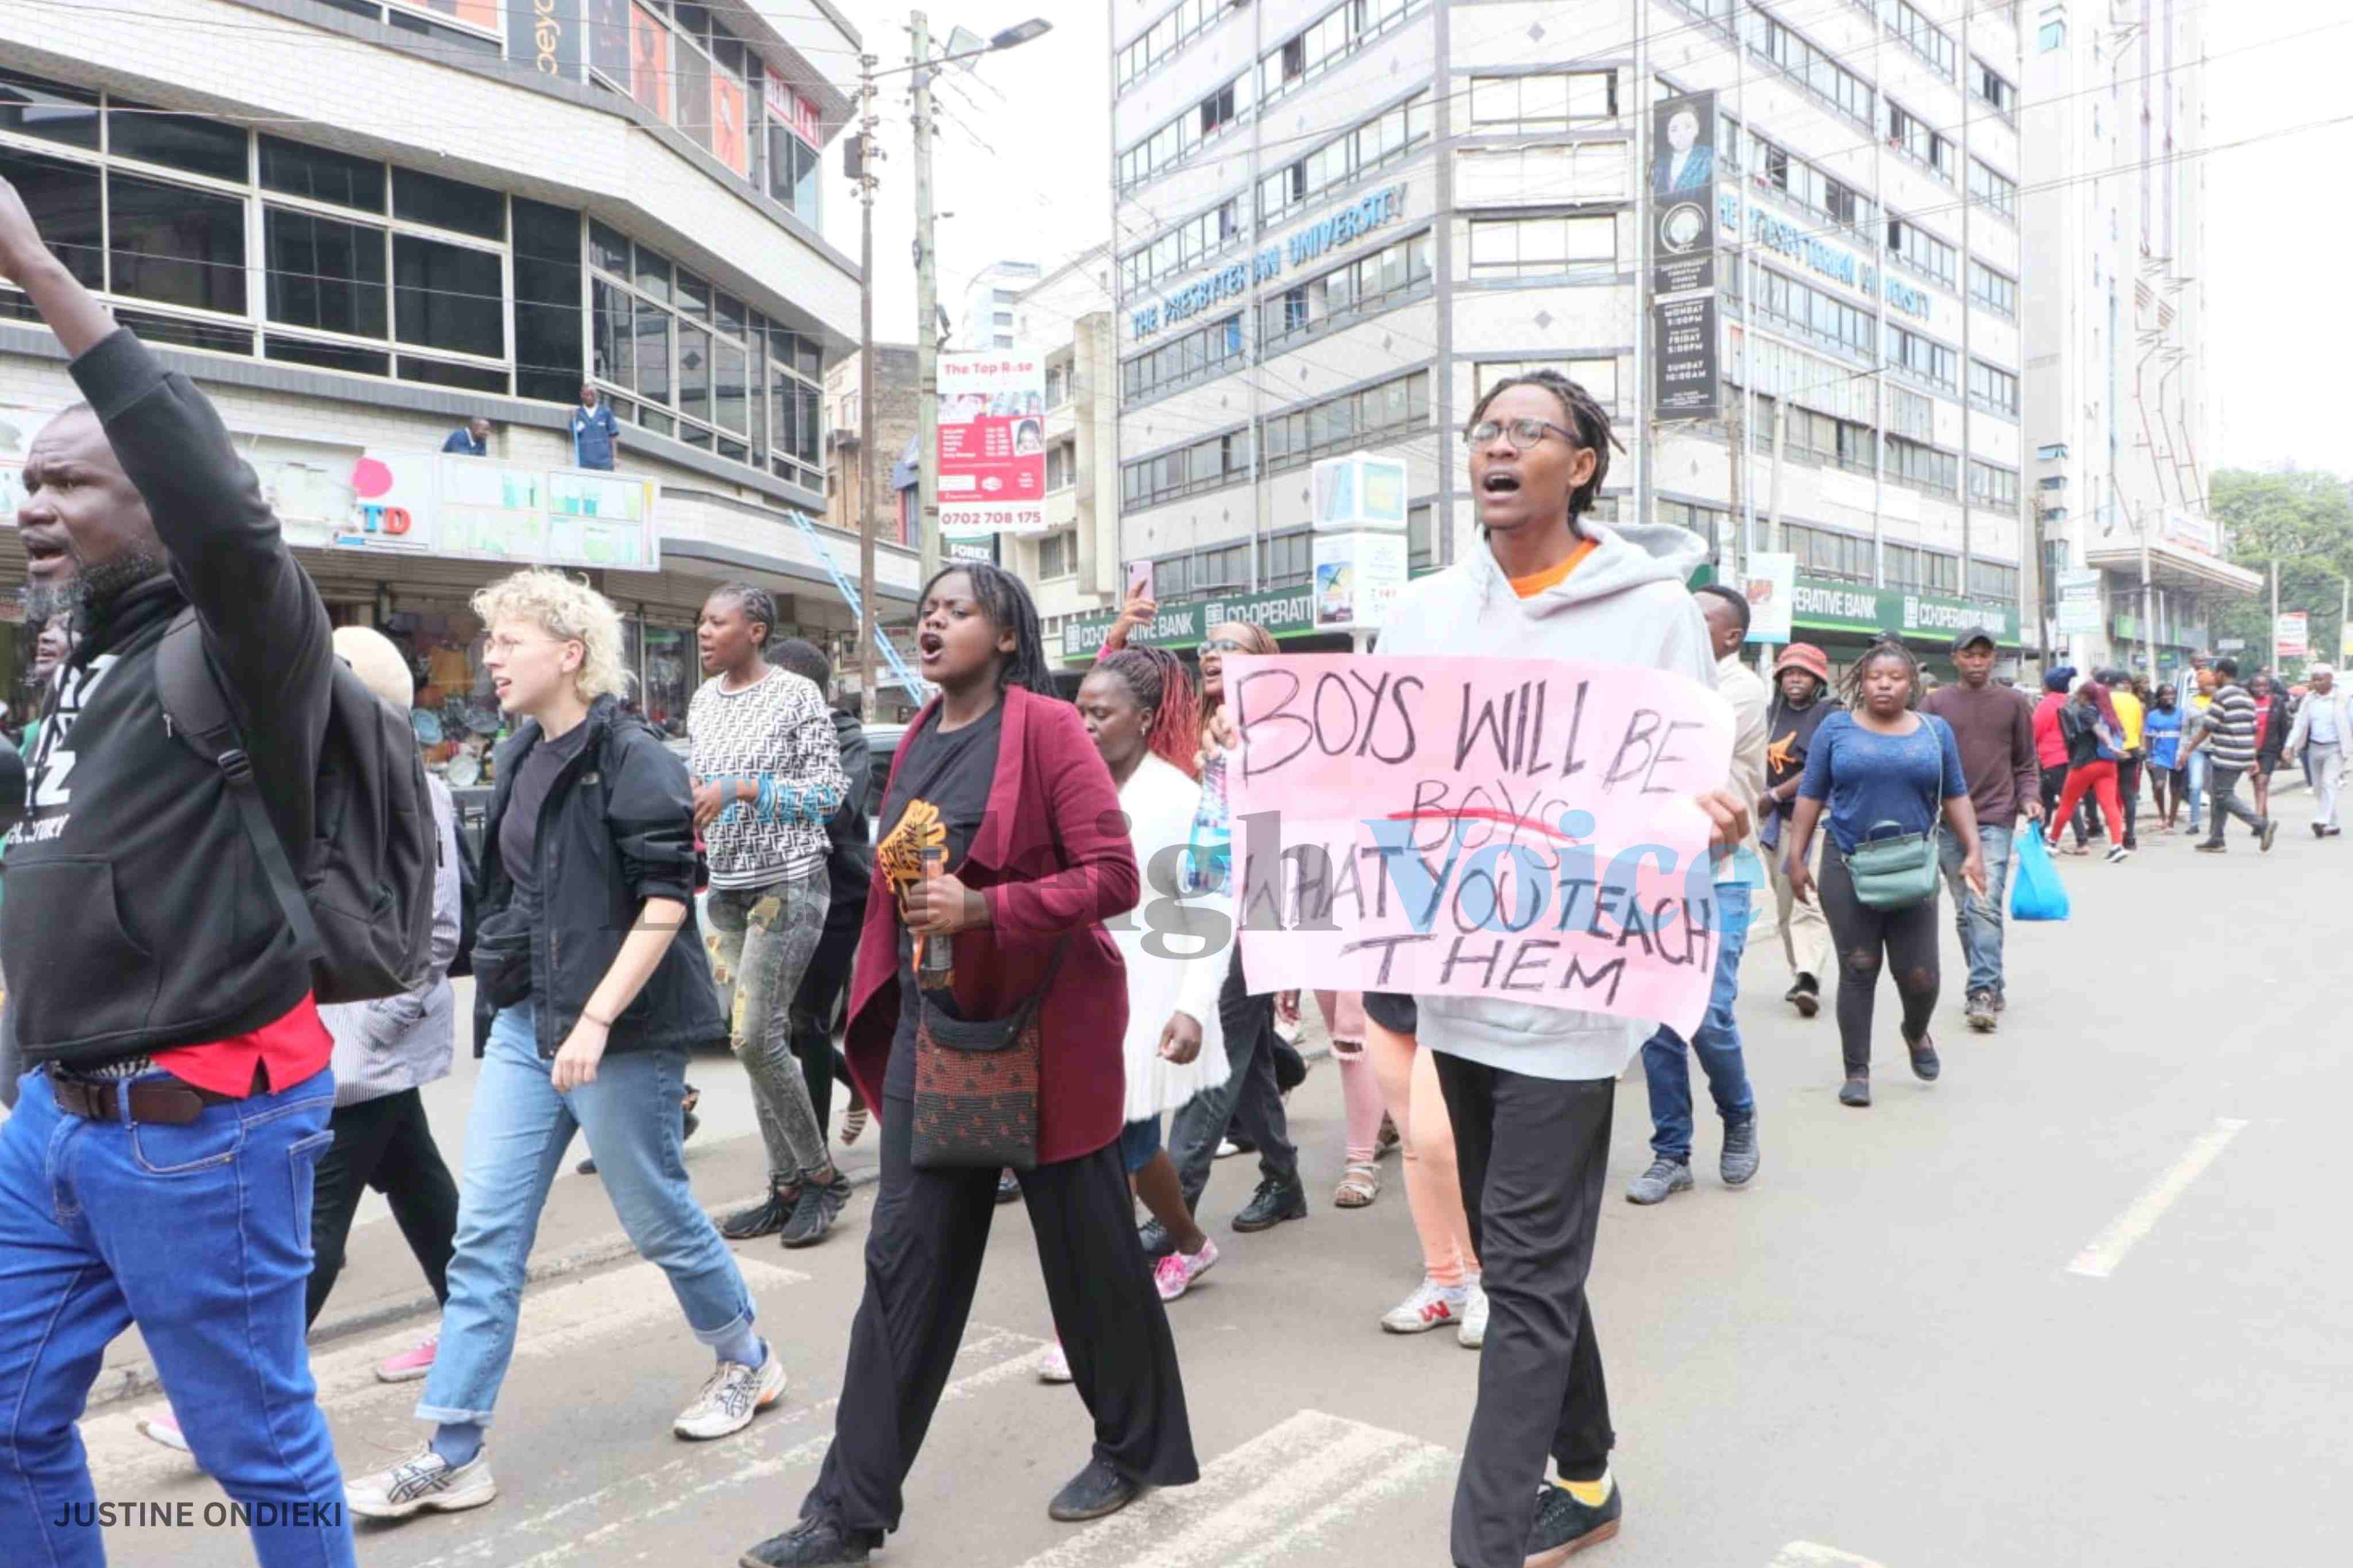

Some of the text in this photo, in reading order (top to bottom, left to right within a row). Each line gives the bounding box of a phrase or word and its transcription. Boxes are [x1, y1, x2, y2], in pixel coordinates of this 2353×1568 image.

[1133, 183, 1407, 341] THE PRESBYTERAN UNIVERSITY
[1664, 304, 1703, 316] MONDAY
[1669, 332, 1700, 345] FRIDAY
[945, 364, 968, 374] The
[974, 364, 997, 376] Top
[1667, 360, 1704, 372] SUNDAY
[942, 511, 1041, 525] 0702 708 175
[950, 543, 990, 561] FOREX
[1226, 595, 1314, 625] CO-OPERATI
[1845, 592, 1877, 620] BANK
[1158, 612, 1195, 638] BANK
[1236, 667, 1704, 795] BOYS WILL BE
[1406, 779, 1570, 871] BOYS
[1237, 842, 1711, 974] WHAT YOU TEACH
[1340, 934, 1627, 1006] THEM
